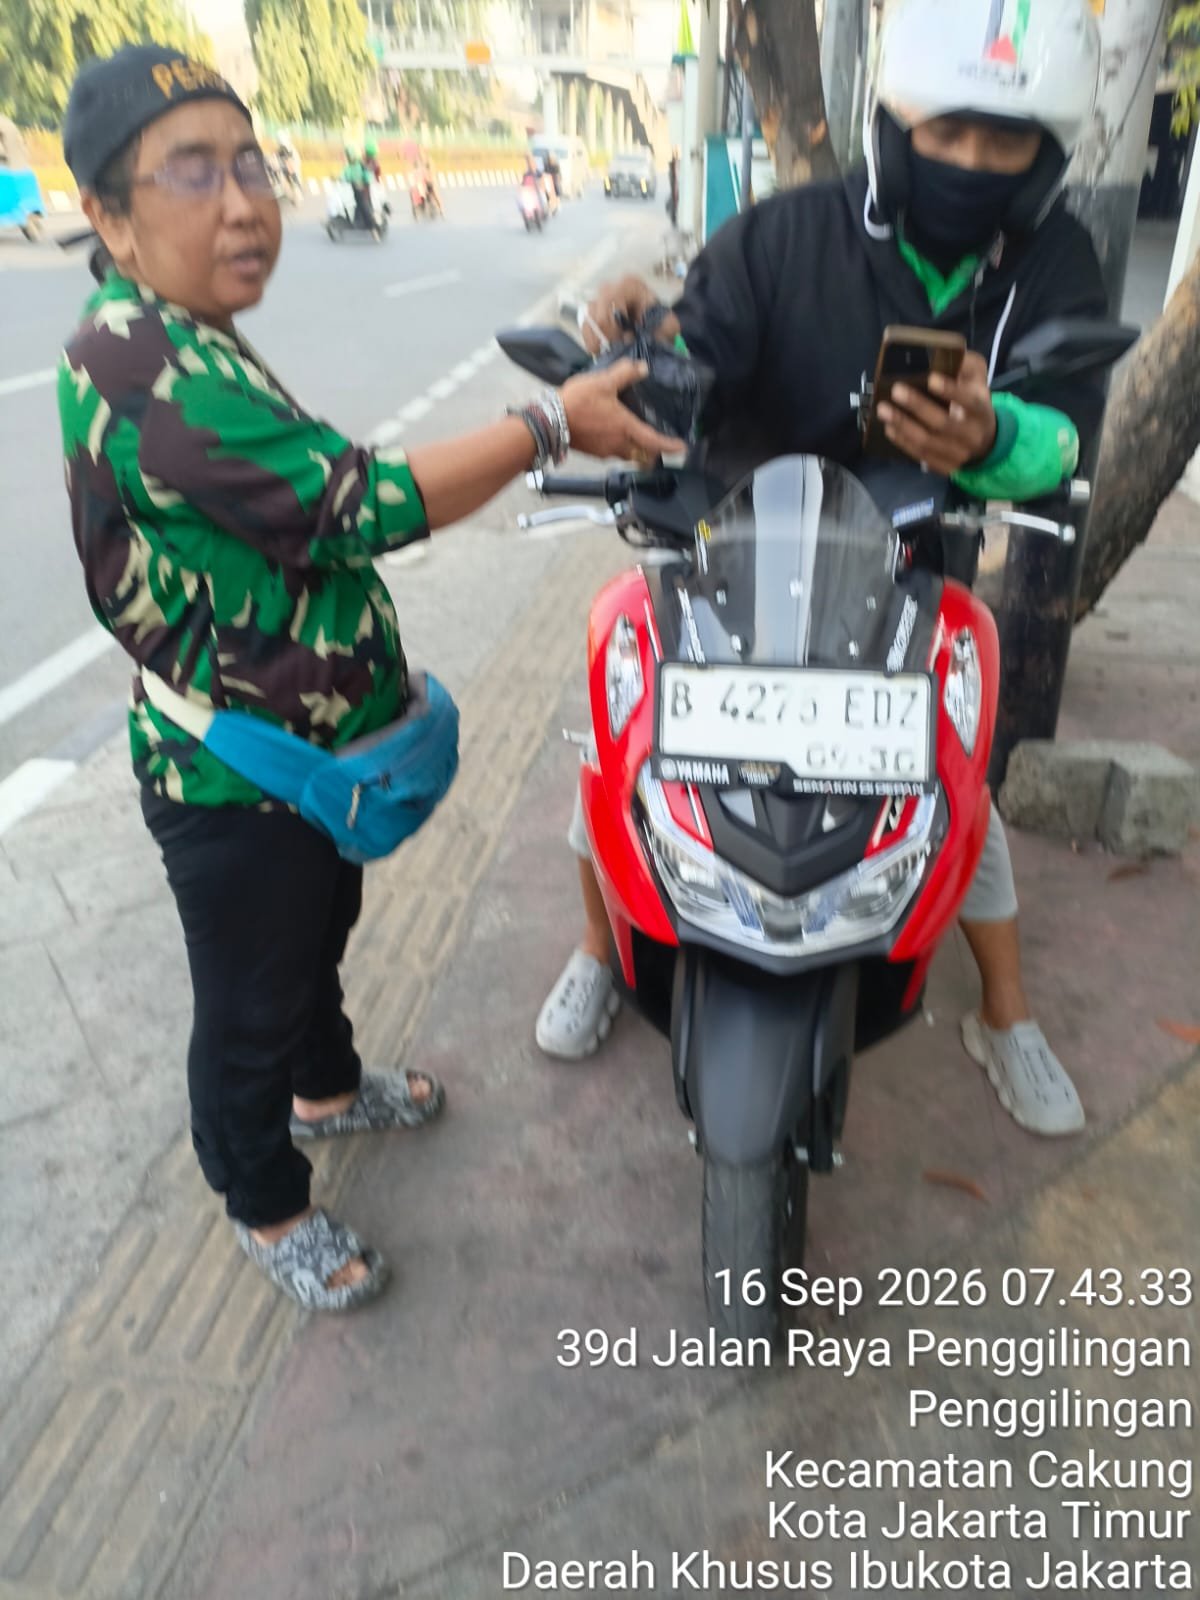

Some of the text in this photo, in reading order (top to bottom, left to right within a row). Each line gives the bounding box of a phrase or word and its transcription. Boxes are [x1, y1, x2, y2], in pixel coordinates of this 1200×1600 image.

[670, 680, 693, 719] B
[844, 686, 919, 730] EDZ
[676, 760, 730, 785] YAMAHA
